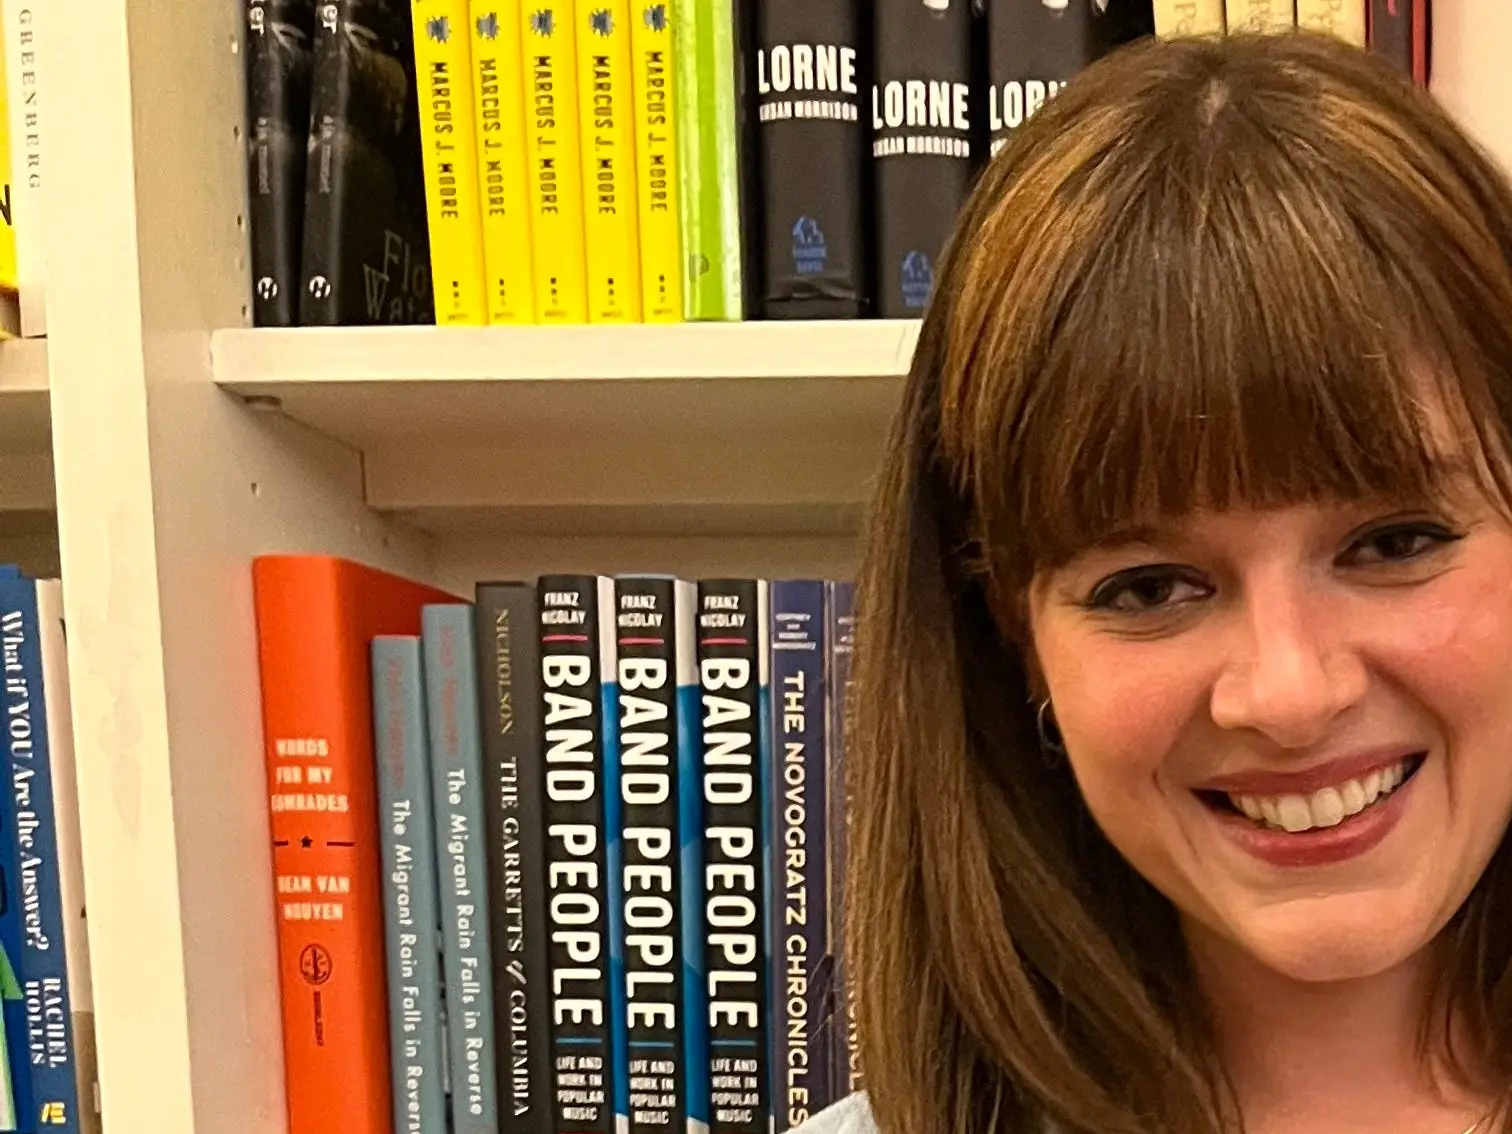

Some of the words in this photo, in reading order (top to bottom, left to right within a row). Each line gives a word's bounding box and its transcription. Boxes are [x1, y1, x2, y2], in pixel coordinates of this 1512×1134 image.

[19, 9, 40, 188] GREENBERG
[430, 62, 453, 134] MARCUS
[758, 44, 857, 95] LORNE
[436, 140, 454, 156] J.
[438, 162, 459, 218] MOORE
[2, 610, 25, 671] What
[6, 678, 28, 698] if
[496, 608, 514, 735] NICHOLSON
[8, 701, 33, 758] YOU
[542, 655, 596, 801] BAND
[783, 671, 804, 734] THE
[12, 763, 35, 806] Are
[499, 756, 519, 809] THE
[17, 811, 40, 848] the
[392, 799, 412, 836] The
[783, 742, 808, 927] NOVOGRATZ
[20, 851, 50, 951] Answer?
[317, 876, 350, 893] VAN
[392, 843, 414, 925] Migrant
[502, 816, 524, 952] GARRETTS
[399, 932, 418, 978] Rain
[548, 823, 603, 1026] PEOPLE
[43, 977, 68, 1068] RACHEL
[402, 985, 422, 1032] Falls
[786, 934, 809, 1127] CHRONICLES
[403, 1039, 421, 1058] in
[509, 990, 530, 1118] COLUMBIA
